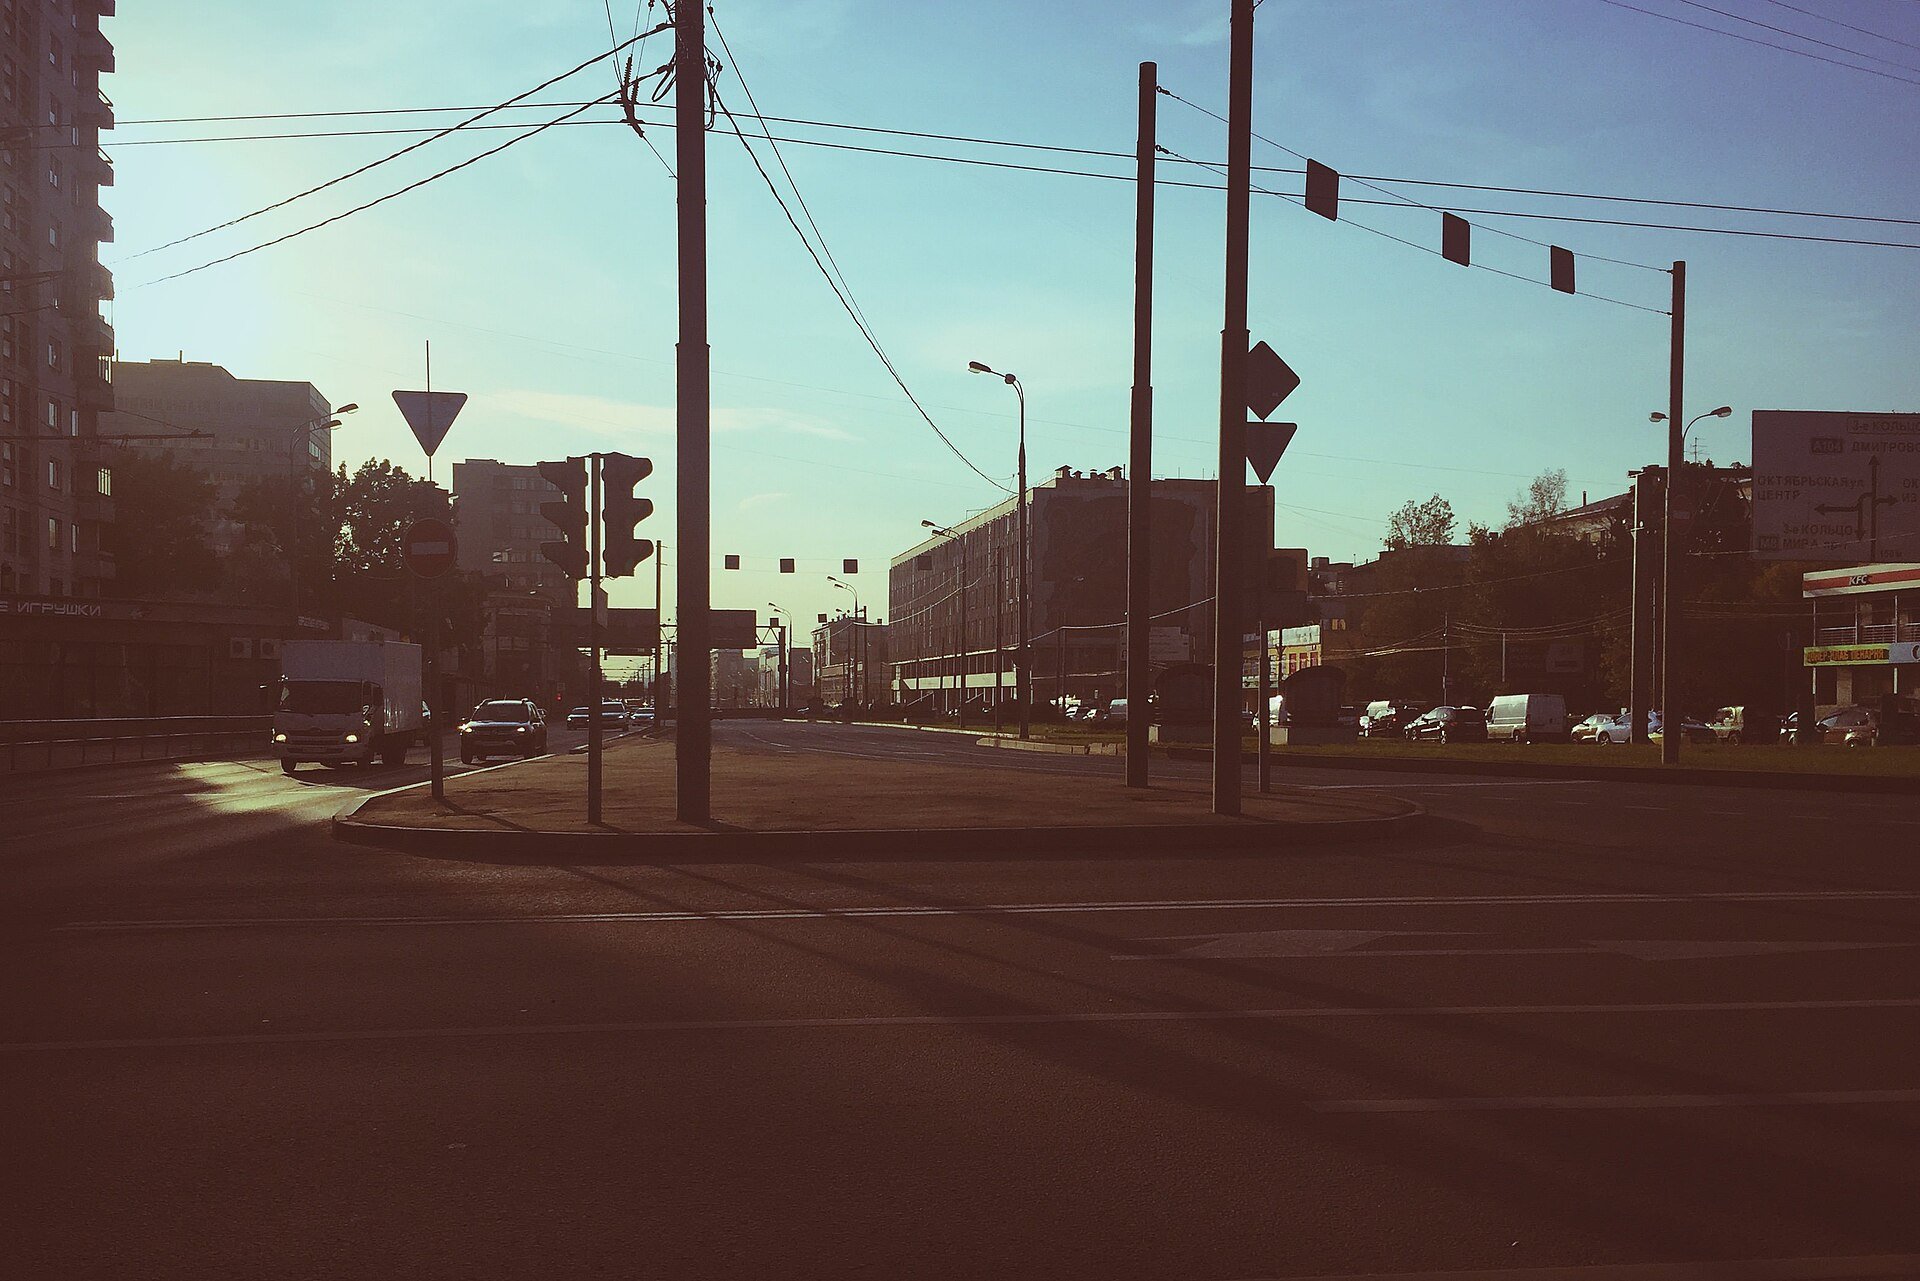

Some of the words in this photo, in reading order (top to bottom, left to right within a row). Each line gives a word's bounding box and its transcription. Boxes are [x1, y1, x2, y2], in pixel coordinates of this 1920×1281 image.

[1757, 475, 1848, 488] ОКТЯБРЬСКАЯ
[1757, 489, 1801, 501] ЦЕНТР
[1801, 524, 1853, 537] КОЛЬЦО
[1783, 538, 1818, 549] МИРА
[1848, 574, 1868, 586] KFC
[16, 601, 102, 617] ИГРУШКИ
